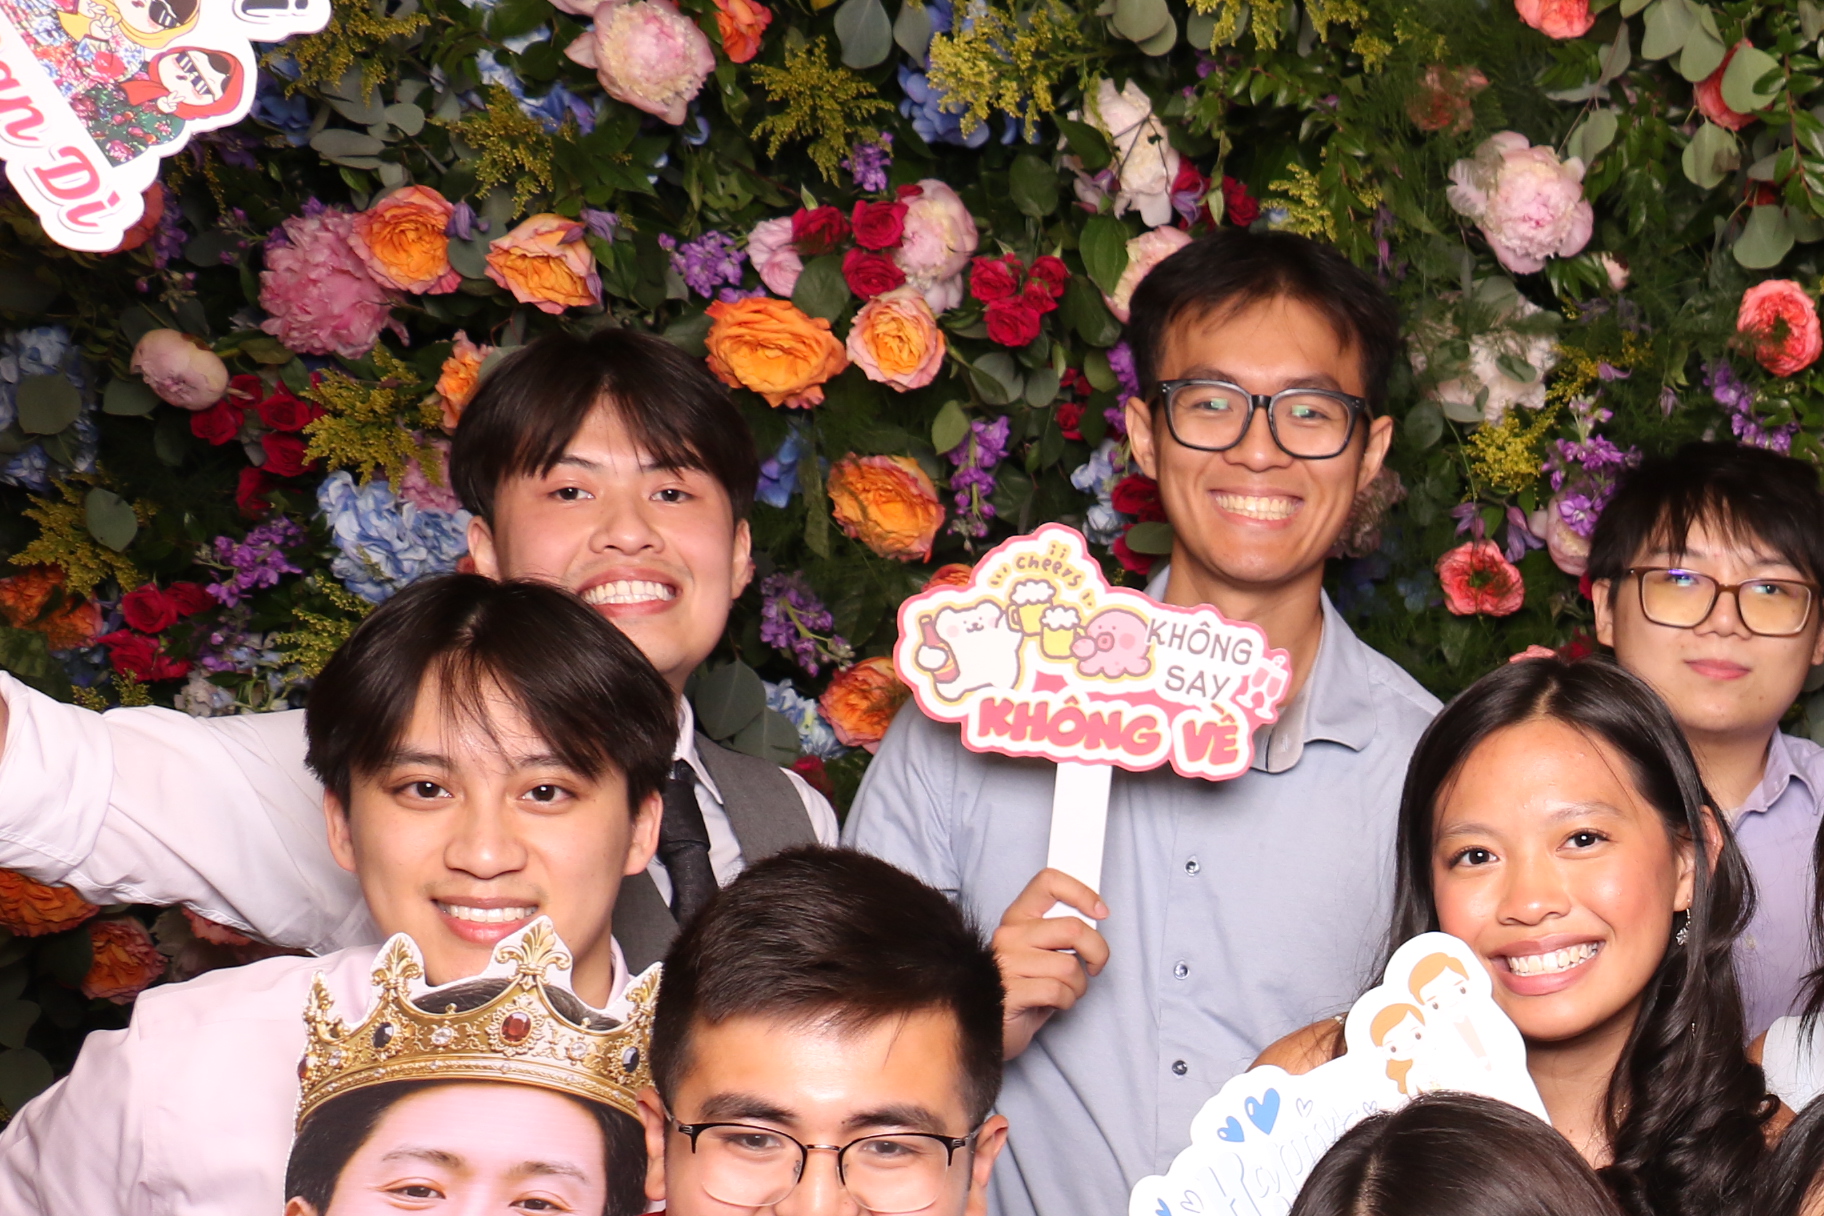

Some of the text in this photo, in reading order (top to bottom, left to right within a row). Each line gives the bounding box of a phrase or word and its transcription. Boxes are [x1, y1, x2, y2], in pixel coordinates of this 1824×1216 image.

[1016, 555, 1082, 587] cheers
[1146, 617, 1254, 665] KHÔNG
[1164, 665, 1231, 699] SAY
[977, 695, 1240, 766] KHÔNG VỀ
